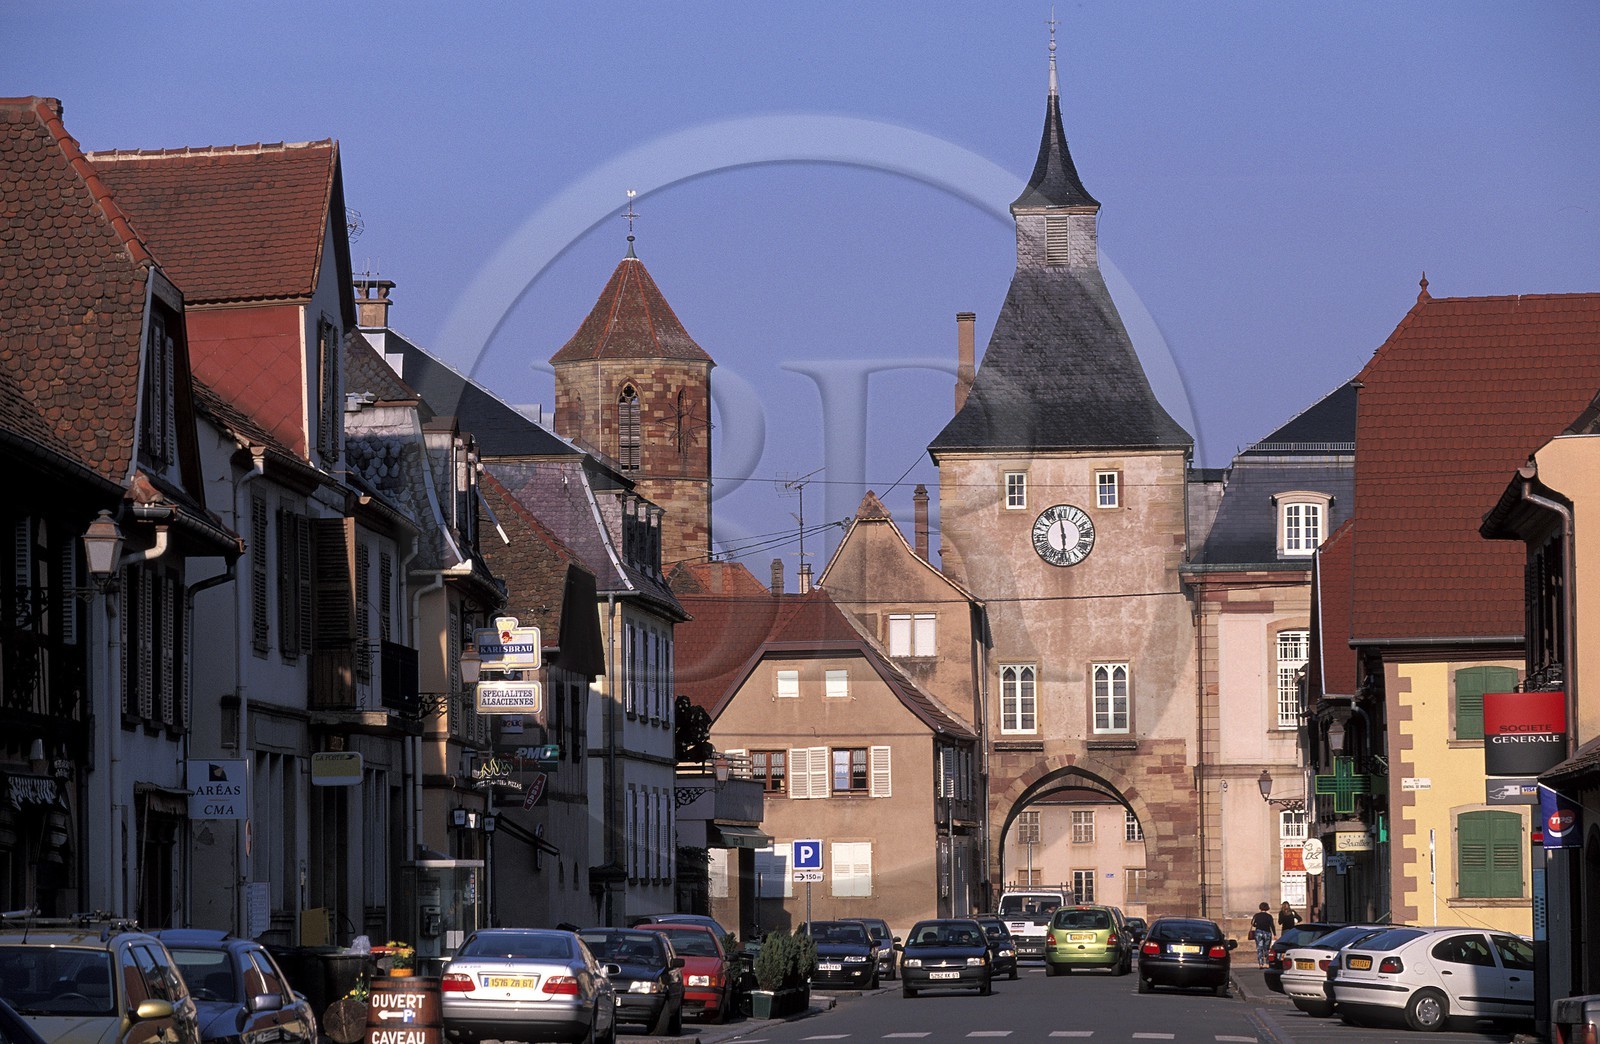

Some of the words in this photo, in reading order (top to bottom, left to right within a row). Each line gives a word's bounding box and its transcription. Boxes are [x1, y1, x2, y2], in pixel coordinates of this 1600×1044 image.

[480, 645, 533, 653] KARLSBRAU
[482, 689, 533, 698] SPECIALITES
[481, 697, 534, 706] ALSACIENNES
[1499, 724, 1553, 732] SOCIETE
[1492, 735, 1560, 744] GENERALE
[516, 747, 552, 760] PMU
[196, 784, 241, 796] ARÉAS
[526, 779, 542, 805] TABAC
[204, 805, 234, 815] CMA
[1551, 816, 1573, 825] TPS
[800, 845, 814, 864] P
[372, 994, 426, 1009] OUVERT
[371, 1031, 426, 1044] CAVEAU
